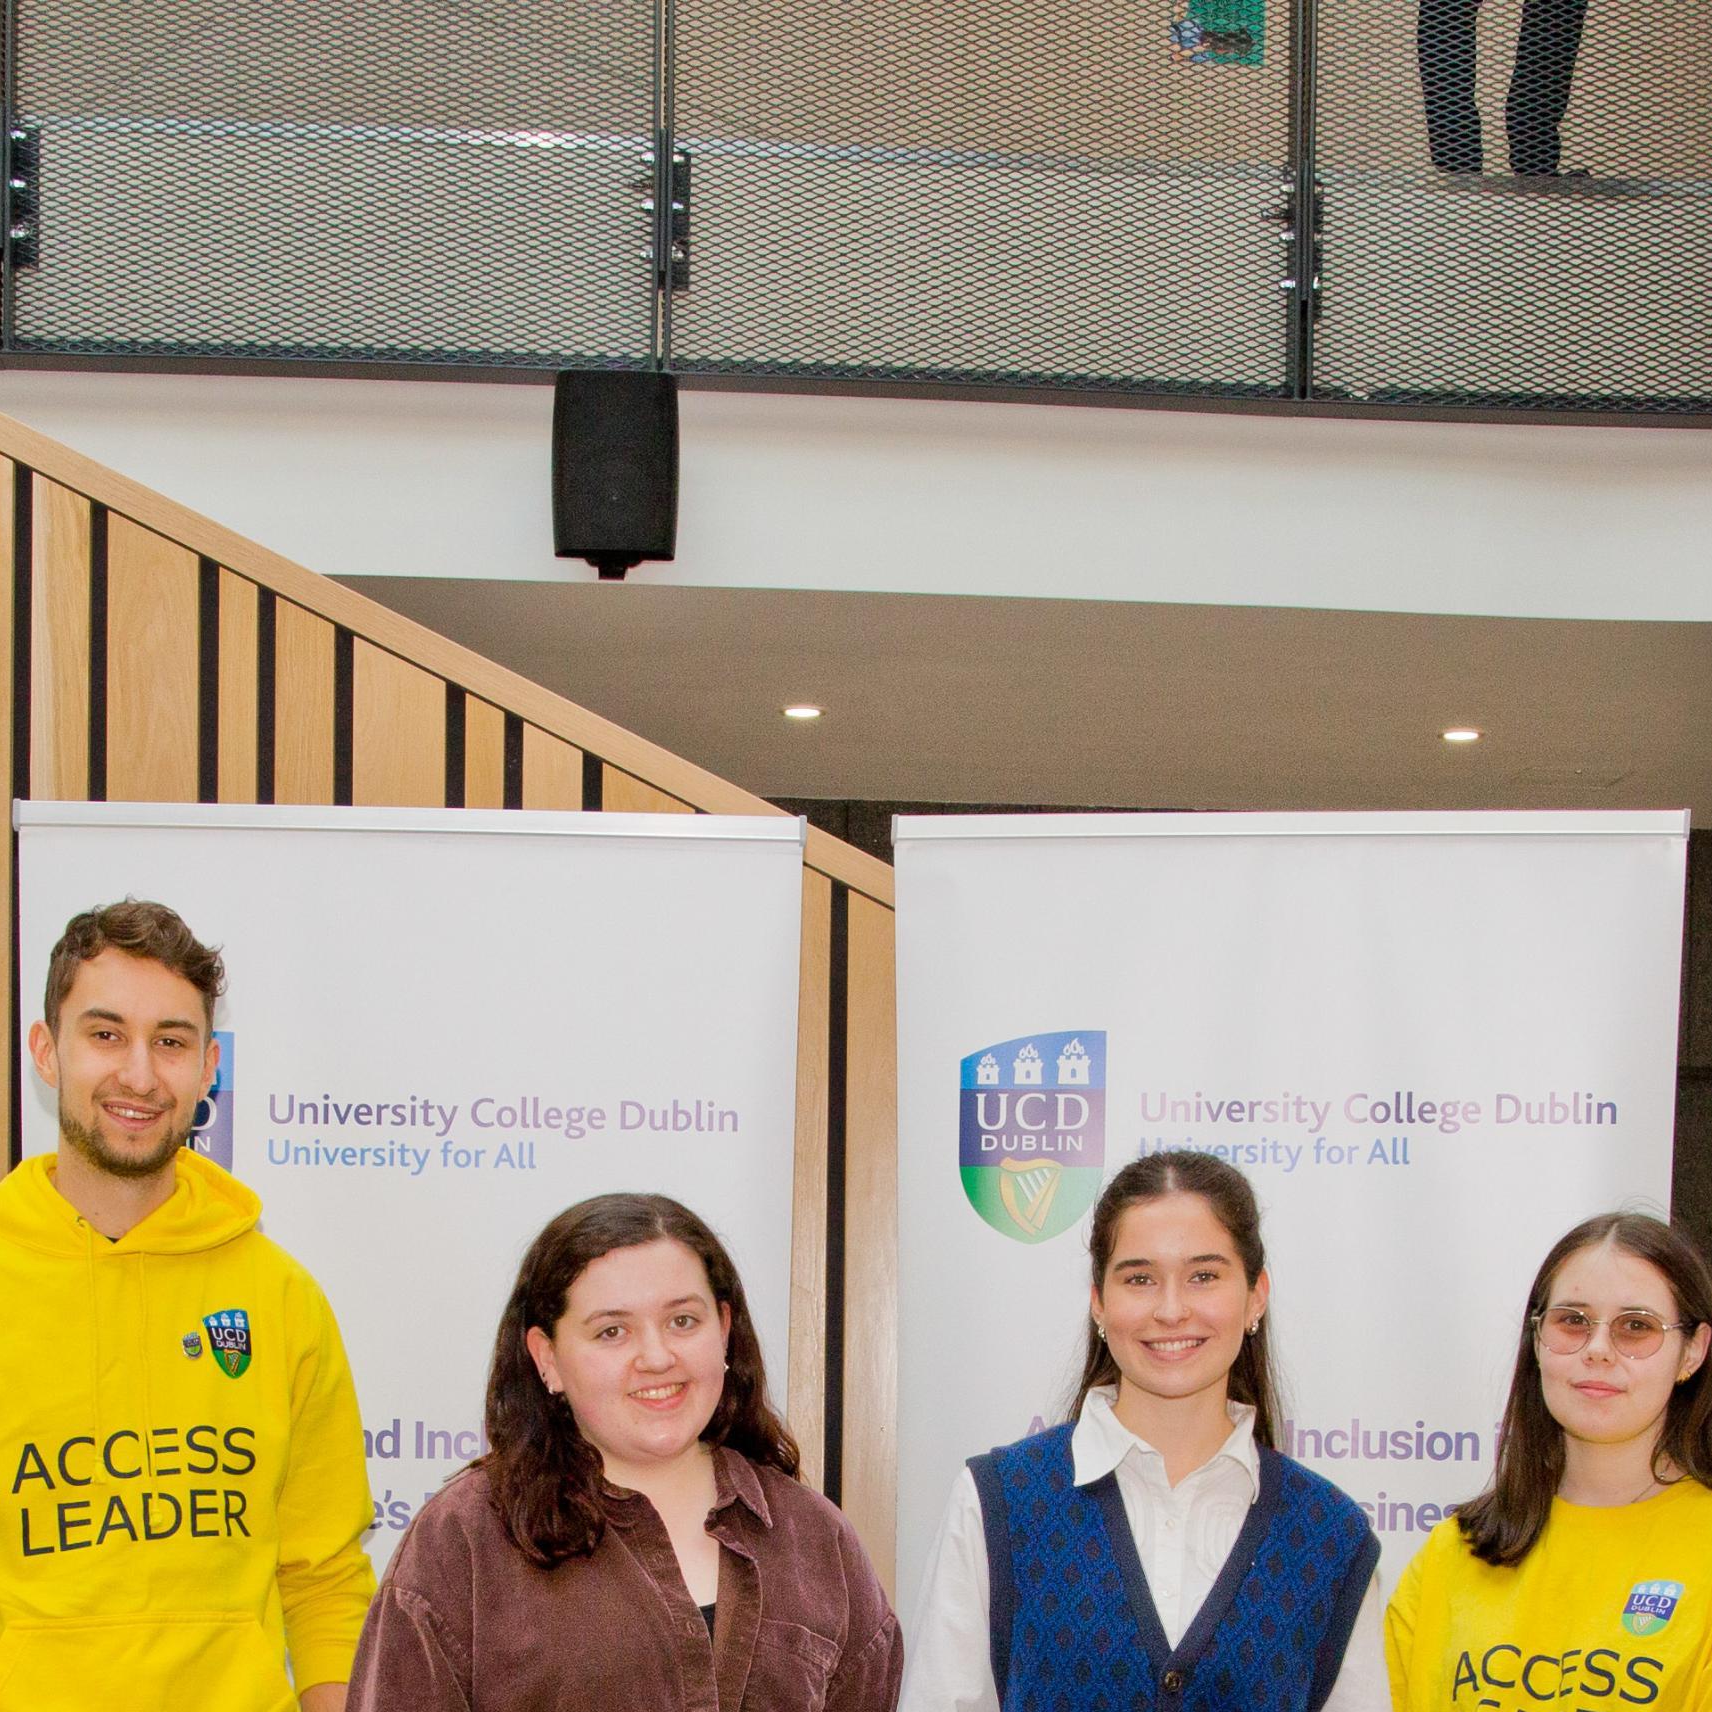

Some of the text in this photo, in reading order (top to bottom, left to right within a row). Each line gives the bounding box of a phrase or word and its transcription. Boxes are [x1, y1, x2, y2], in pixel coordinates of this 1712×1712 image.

[268, 1094, 739, 1139] University College Dublin
[975, 1092, 1091, 1133] UCD
[1140, 1091, 1618, 1134] University College Dublin
[268, 1139, 536, 1176] University for All
[980, 1133, 1084, 1153] DUBLIN
[1313, 1137, 1360, 1165] for
[1367, 1137, 1410, 1165] All
[211, 1327, 247, 1343] UCD
[216, 1340, 246, 1351] DUBLIN
[12, 1425, 256, 1494] ACCESS
[1285, 1418, 1480, 1462] Inclusion
[21, 1489, 252, 1557] LEADER
[1631, 1605, 1666, 1615] DUBLIN
[1632, 1594, 1672, 1610] UCD
[1452, 1644, 1664, 1705] ACCESS
